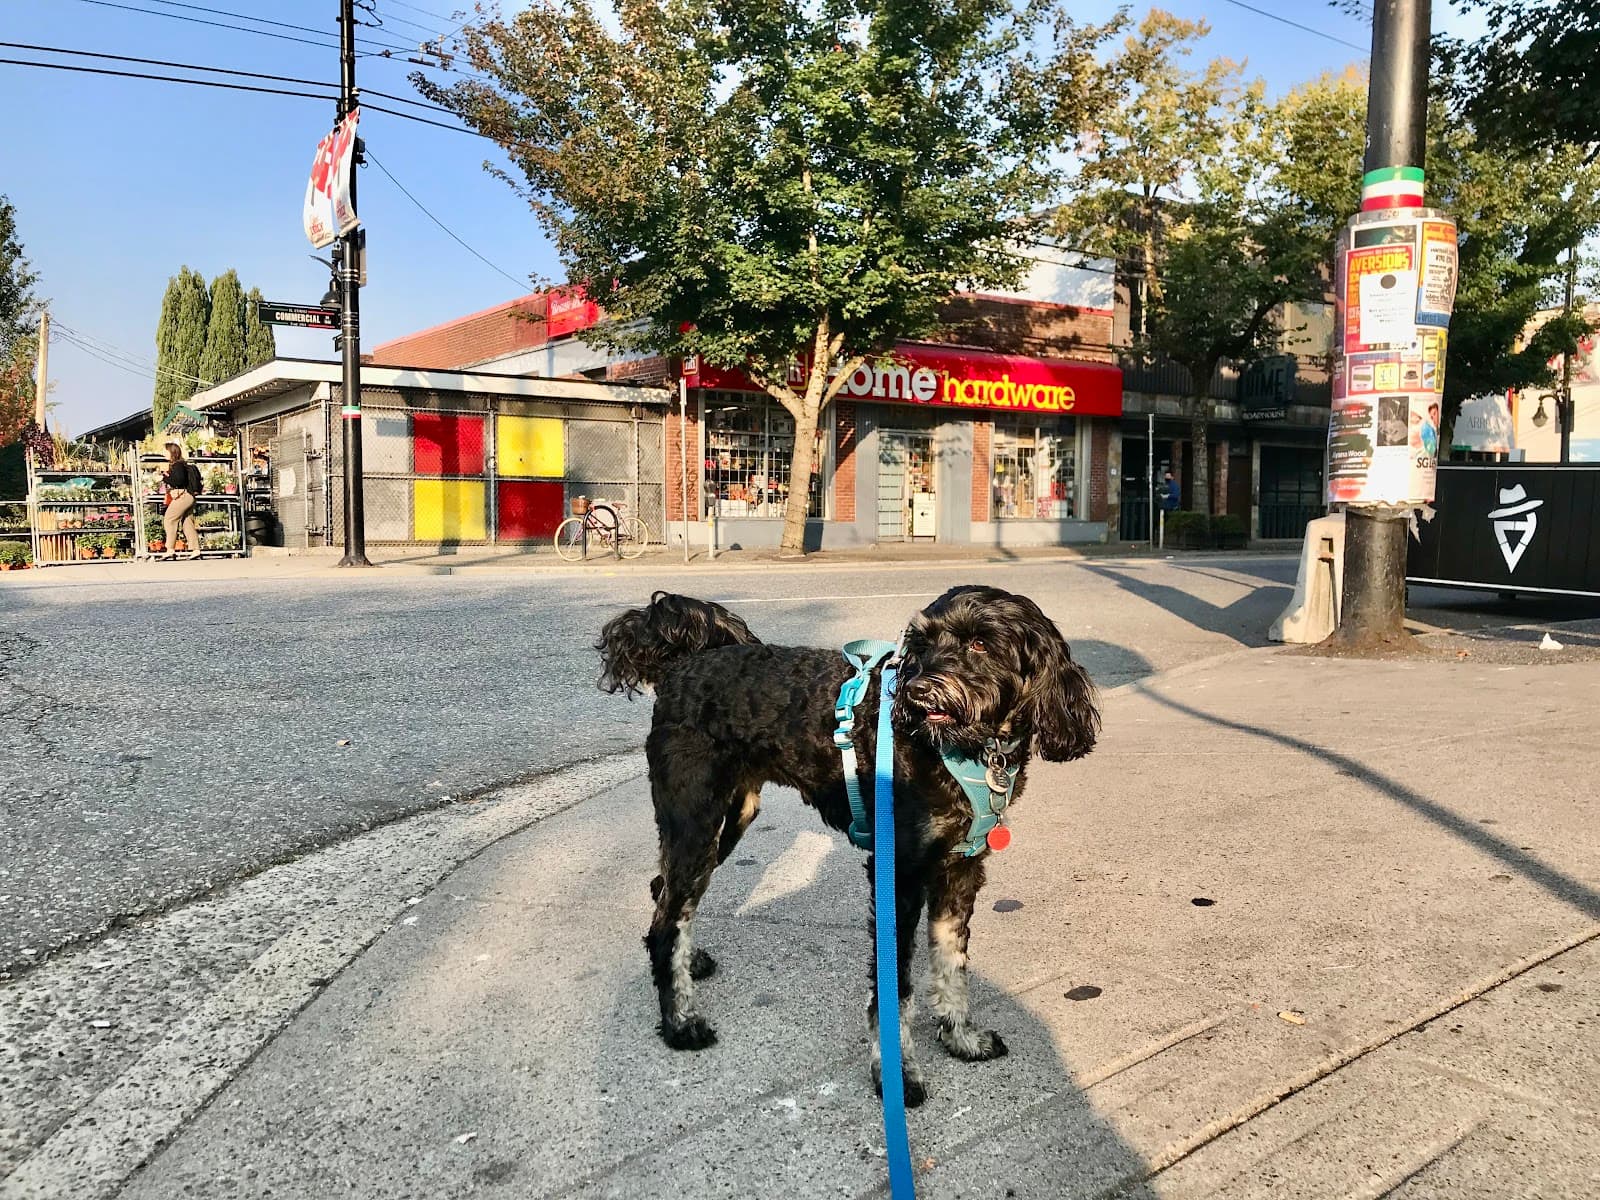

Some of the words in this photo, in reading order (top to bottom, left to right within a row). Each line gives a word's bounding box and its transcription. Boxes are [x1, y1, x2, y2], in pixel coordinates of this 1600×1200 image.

[1350, 252, 1409, 272] AVERSIONS
[275, 311, 321, 324] COMMERCIAL
[942, 370, 1075, 410] hardware
